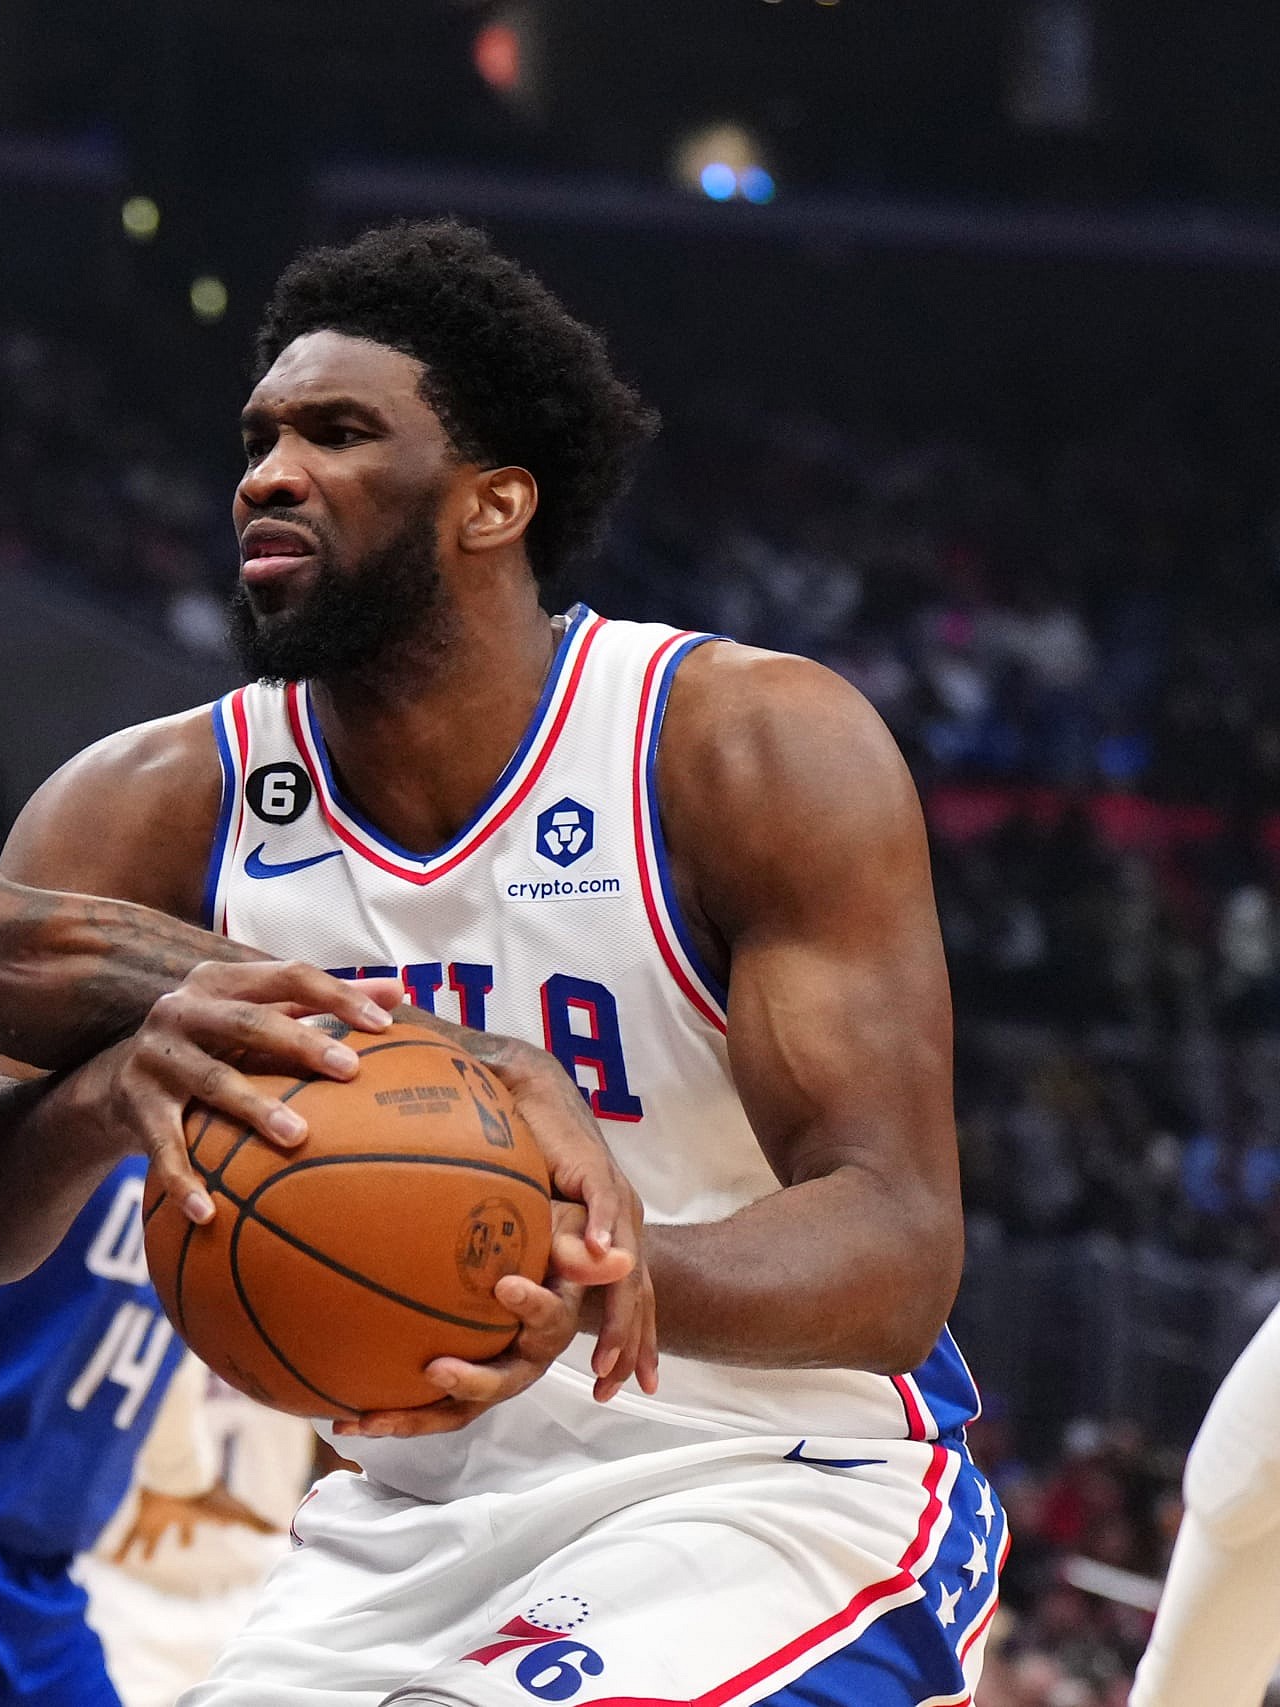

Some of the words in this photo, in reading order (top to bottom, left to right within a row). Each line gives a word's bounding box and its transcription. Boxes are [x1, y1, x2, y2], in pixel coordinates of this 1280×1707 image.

[261, 771, 296, 816] 6
[507, 879, 620, 899] crypto.com
[67, 1303, 178, 1430] 14
[459, 1615, 604, 1701] 76
